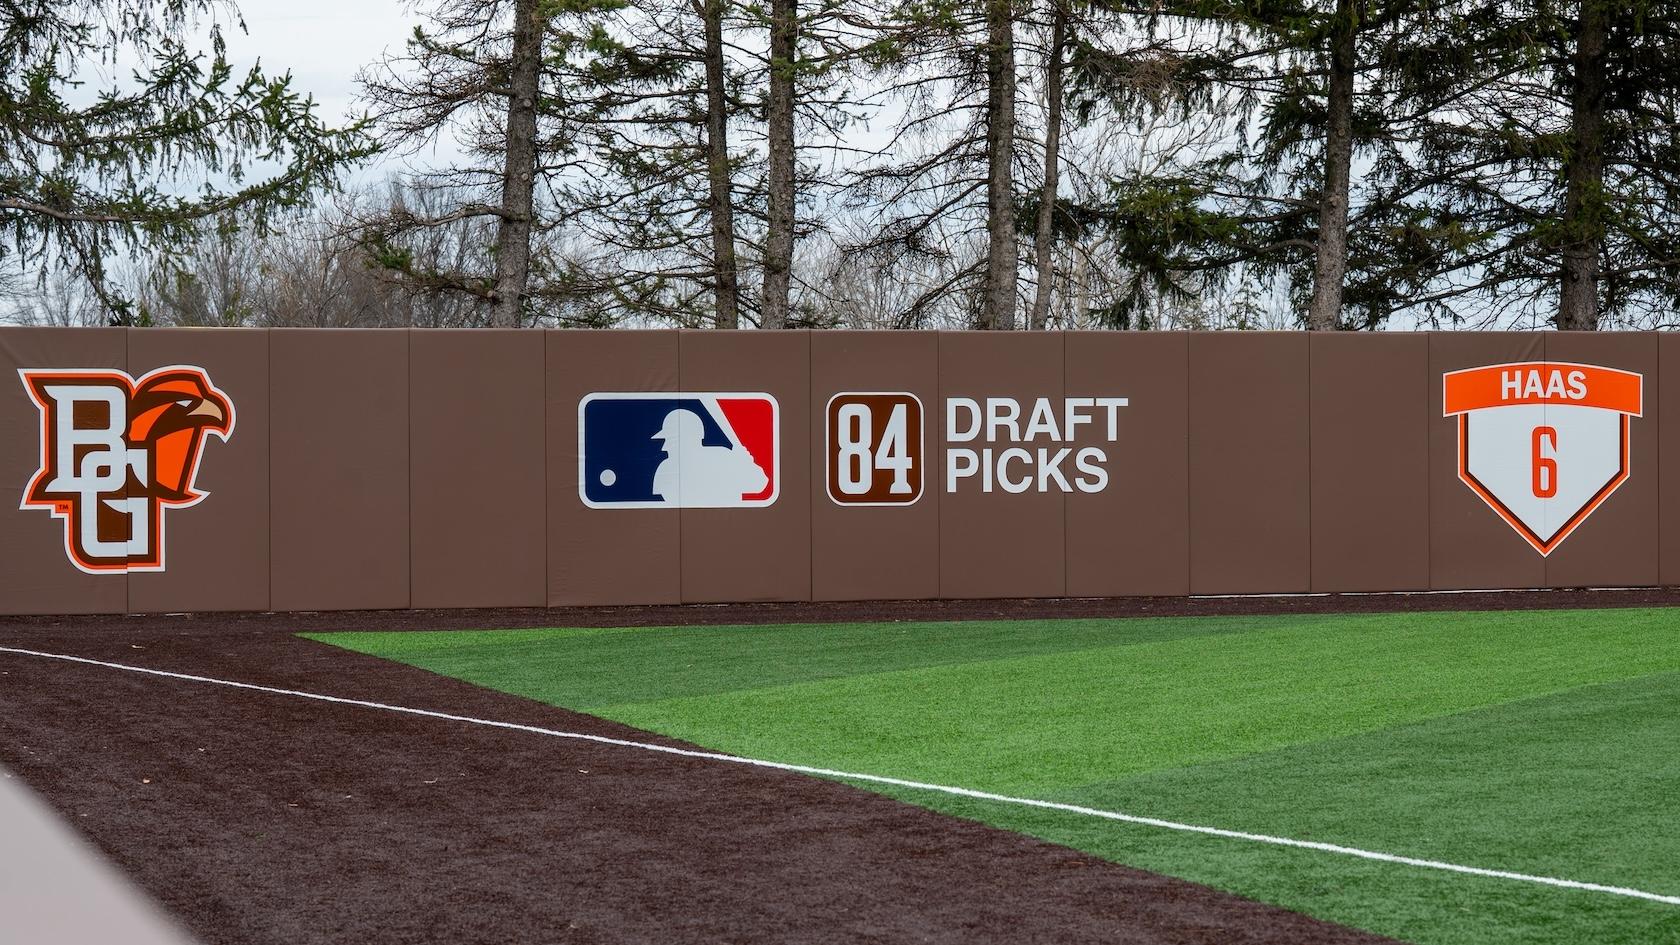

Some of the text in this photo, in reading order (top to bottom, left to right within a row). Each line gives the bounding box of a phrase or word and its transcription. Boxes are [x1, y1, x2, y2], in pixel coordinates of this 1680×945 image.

[1501, 369, 1588, 400] HAAS
[838, 403, 913, 495] 84
[946, 397, 1129, 442] DRAFT
[43, 385, 149, 558] BG
[946, 447, 1110, 494] PICKS
[1531, 425, 1557, 499] 6
